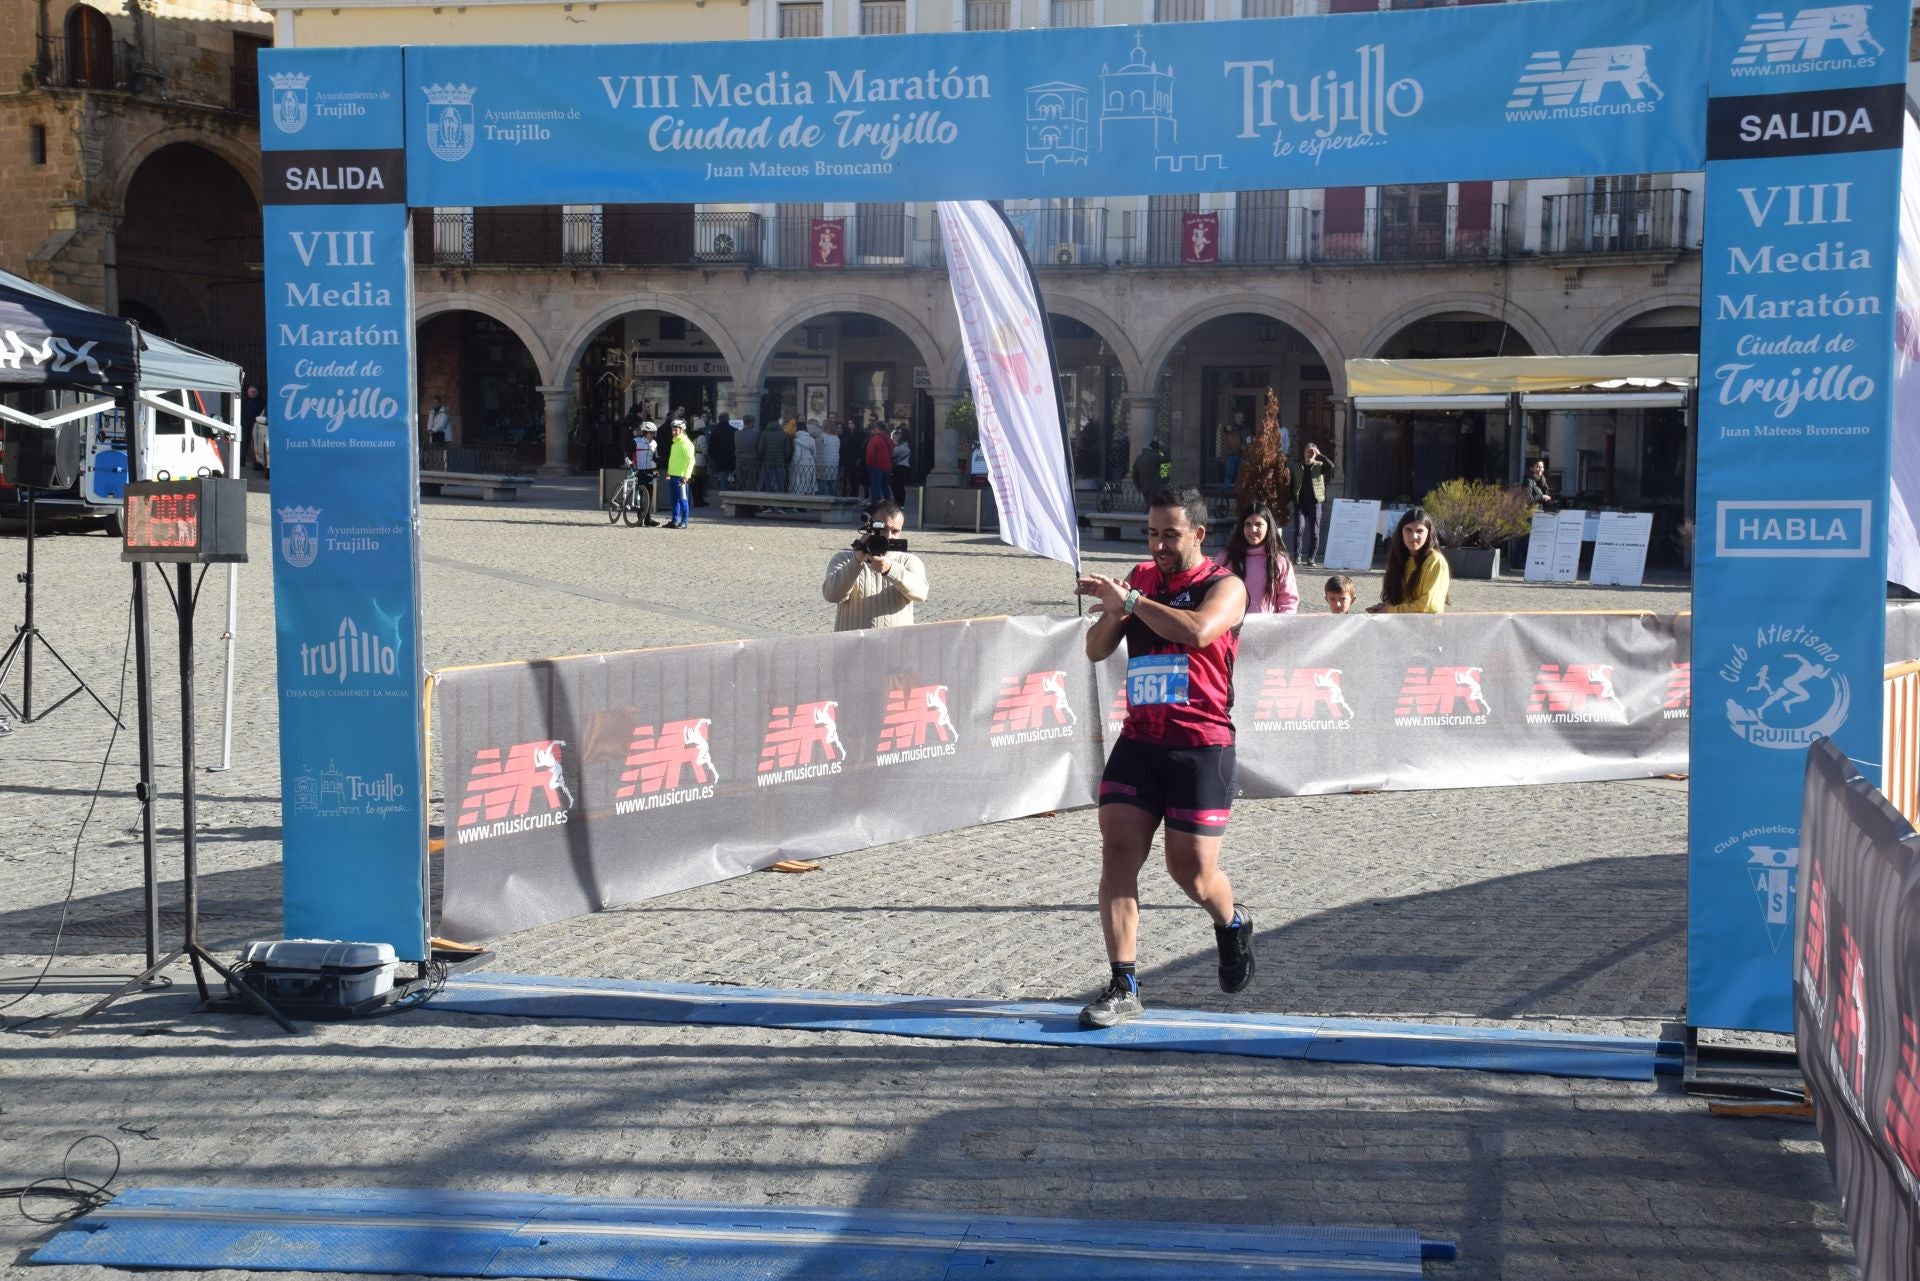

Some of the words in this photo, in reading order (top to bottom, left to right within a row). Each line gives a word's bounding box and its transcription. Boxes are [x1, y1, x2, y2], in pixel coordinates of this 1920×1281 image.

[1731, 57, 1876, 78] www.musicrun.es
[315, 90, 377, 102] Ayuntamiento
[379, 90, 391, 100] de
[598, 75, 679, 109] VIII
[692, 70, 814, 108] Media
[825, 65, 991, 104] Maratón
[1224, 43, 1424, 139] Trujillo
[315, 103, 366, 118] Trujillo
[484, 108, 564, 123] Ayuntamiento
[567, 108, 581, 120] de
[1505, 101, 1655, 122] www.musicrun.es
[484, 124, 551, 143] Trujillo
[649, 115, 773, 152] Ciudad
[779, 115, 825, 149] de
[833, 109, 959, 160] Trujillo
[1739, 107, 1874, 143] SALIDA
[1273, 129, 1294, 158] te
[285, 166, 385, 191] SALIDA
[705, 162, 744, 181] Juan
[749, 161, 809, 177] Mateos
[815, 160, 893, 176] Broncano
[1737, 182, 1854, 228] VIII
[289, 231, 376, 267] VIII
[1727, 241, 1873, 275] Media
[285, 281, 392, 307] Media
[1716, 290, 1882, 321] Maratón
[279, 323, 400, 347] Maratón
[1736, 333, 1822, 357] Ciudad
[1825, 333, 1858, 353] de
[294, 358, 359, 378] Ciudad
[360, 360, 383, 377] de
[1714, 363, 1875, 419] Trujillo
[279, 383, 399, 433] Trujillo
[285, 438, 308, 449] Juan
[310, 438, 346, 448] Mateos
[348, 438, 396, 448] Broncano
[1720, 426, 1750, 439] Juan
[1754, 425, 1802, 436] Mateos
[1806, 424, 1870, 436] Broncano
[327, 525, 391, 536] Ayuntamiento
[393, 525, 404, 533] de
[1738, 517, 1848, 541] HABLA
[326, 538, 380, 554] Trujillo
[301, 617, 395, 684] trujillo
[1719, 643, 1749, 683] Club
[1756, 623, 1840, 662] Atletismo
[1132, 674, 1168, 705] 561
[1254, 718, 1350, 732] www.musicrun.es
[1394, 714, 1487, 728] www.musicrun.es
[991, 724, 1073, 748] www.musicrun.es
[876, 742, 956, 767] www.musicrun.es
[757, 760, 842, 787] www.musicrun.es
[347, 773, 403, 801] Trujillo
[615, 784, 714, 815] www.musicrun.es
[366, 802, 374, 815] te
[458, 810, 568, 844] www.musicrun.es
[1713, 835, 1739, 854] Club
[1742, 825, 1796, 840] Athletico
